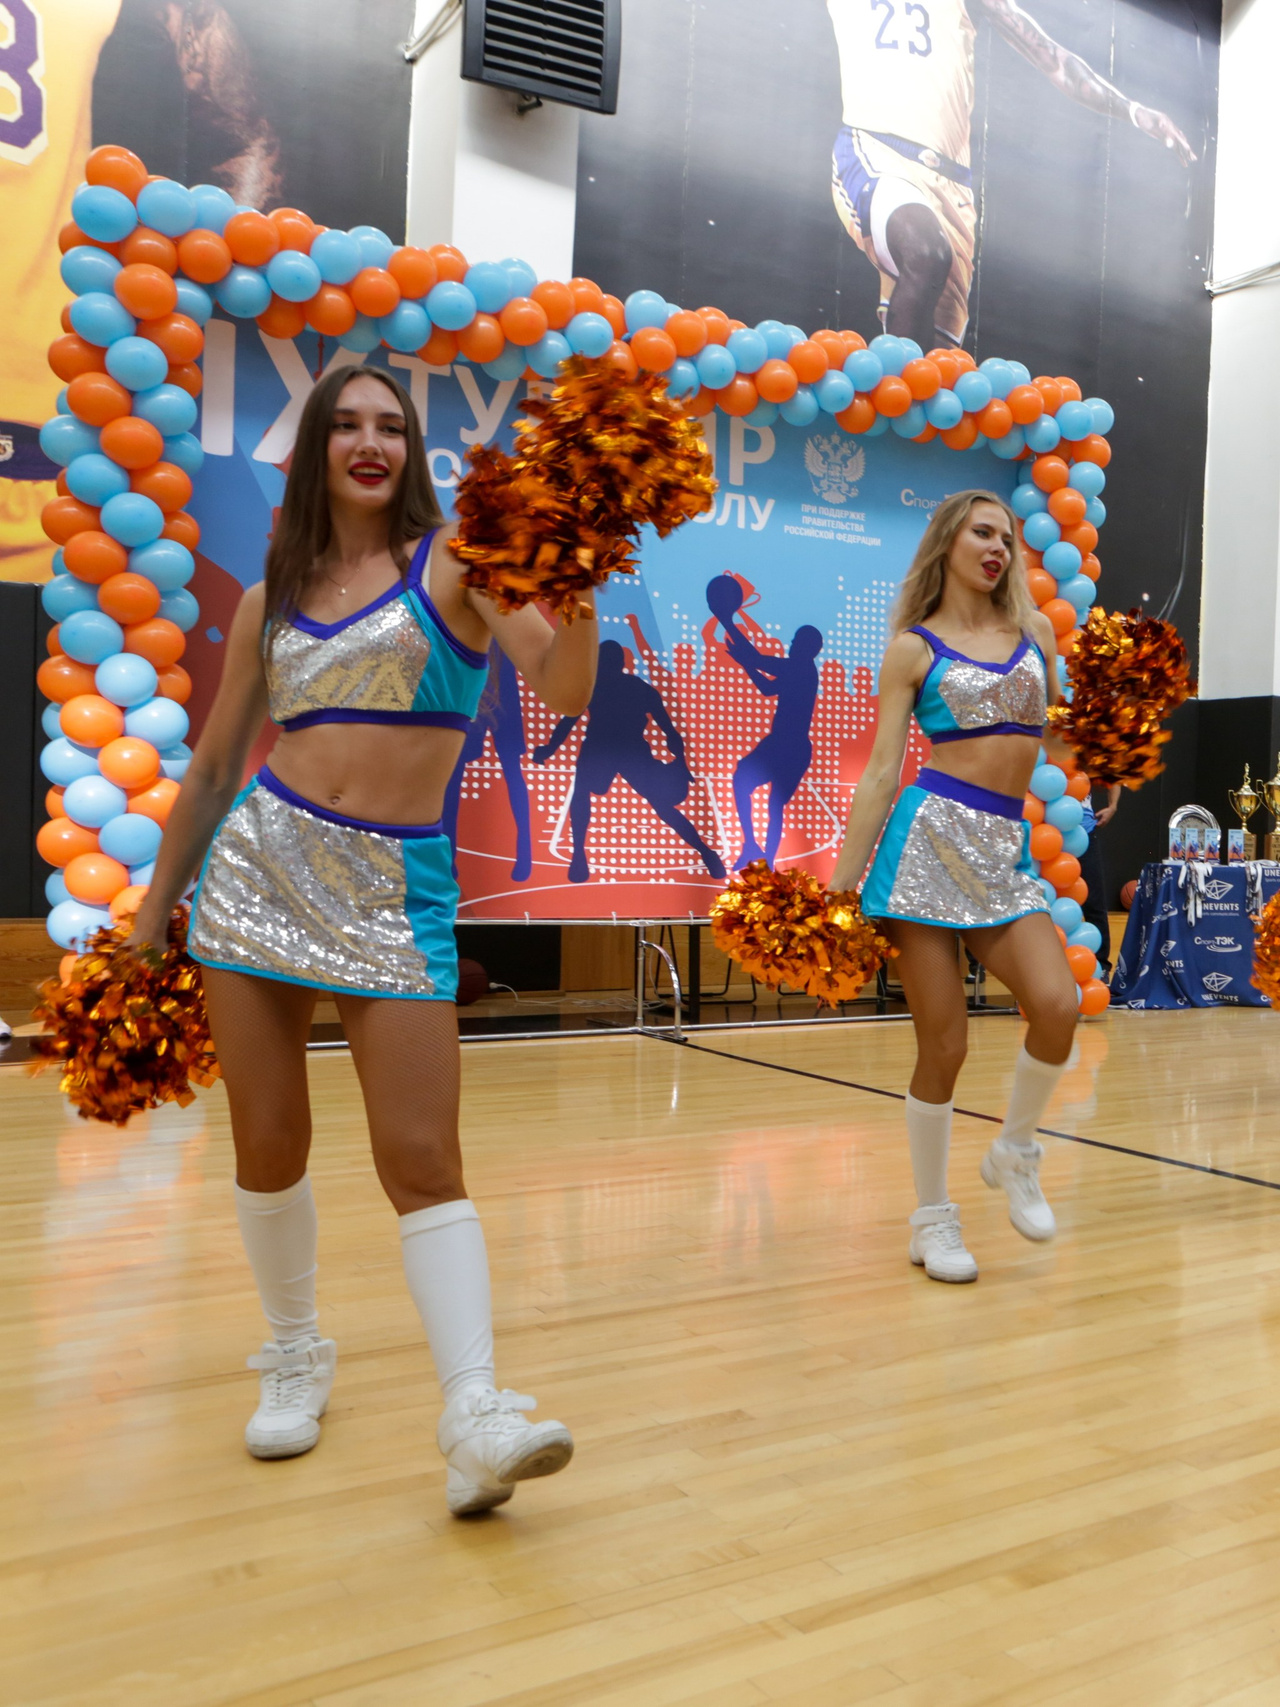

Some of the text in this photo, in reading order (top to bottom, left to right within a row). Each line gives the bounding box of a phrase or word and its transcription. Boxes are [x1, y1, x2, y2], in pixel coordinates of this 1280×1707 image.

[870, 0, 932, 58] 23
[801, 503, 866, 521] ПРИ ПОДДЕРЖКЕ
[802, 515, 865, 533] ПРАВИТЕЛЬСТВА
[784, 525, 881, 546] РОССИЙСКОЙ ФЕДЕРАЦИИ
[1202, 902, 1240, 911] NEVENTS
